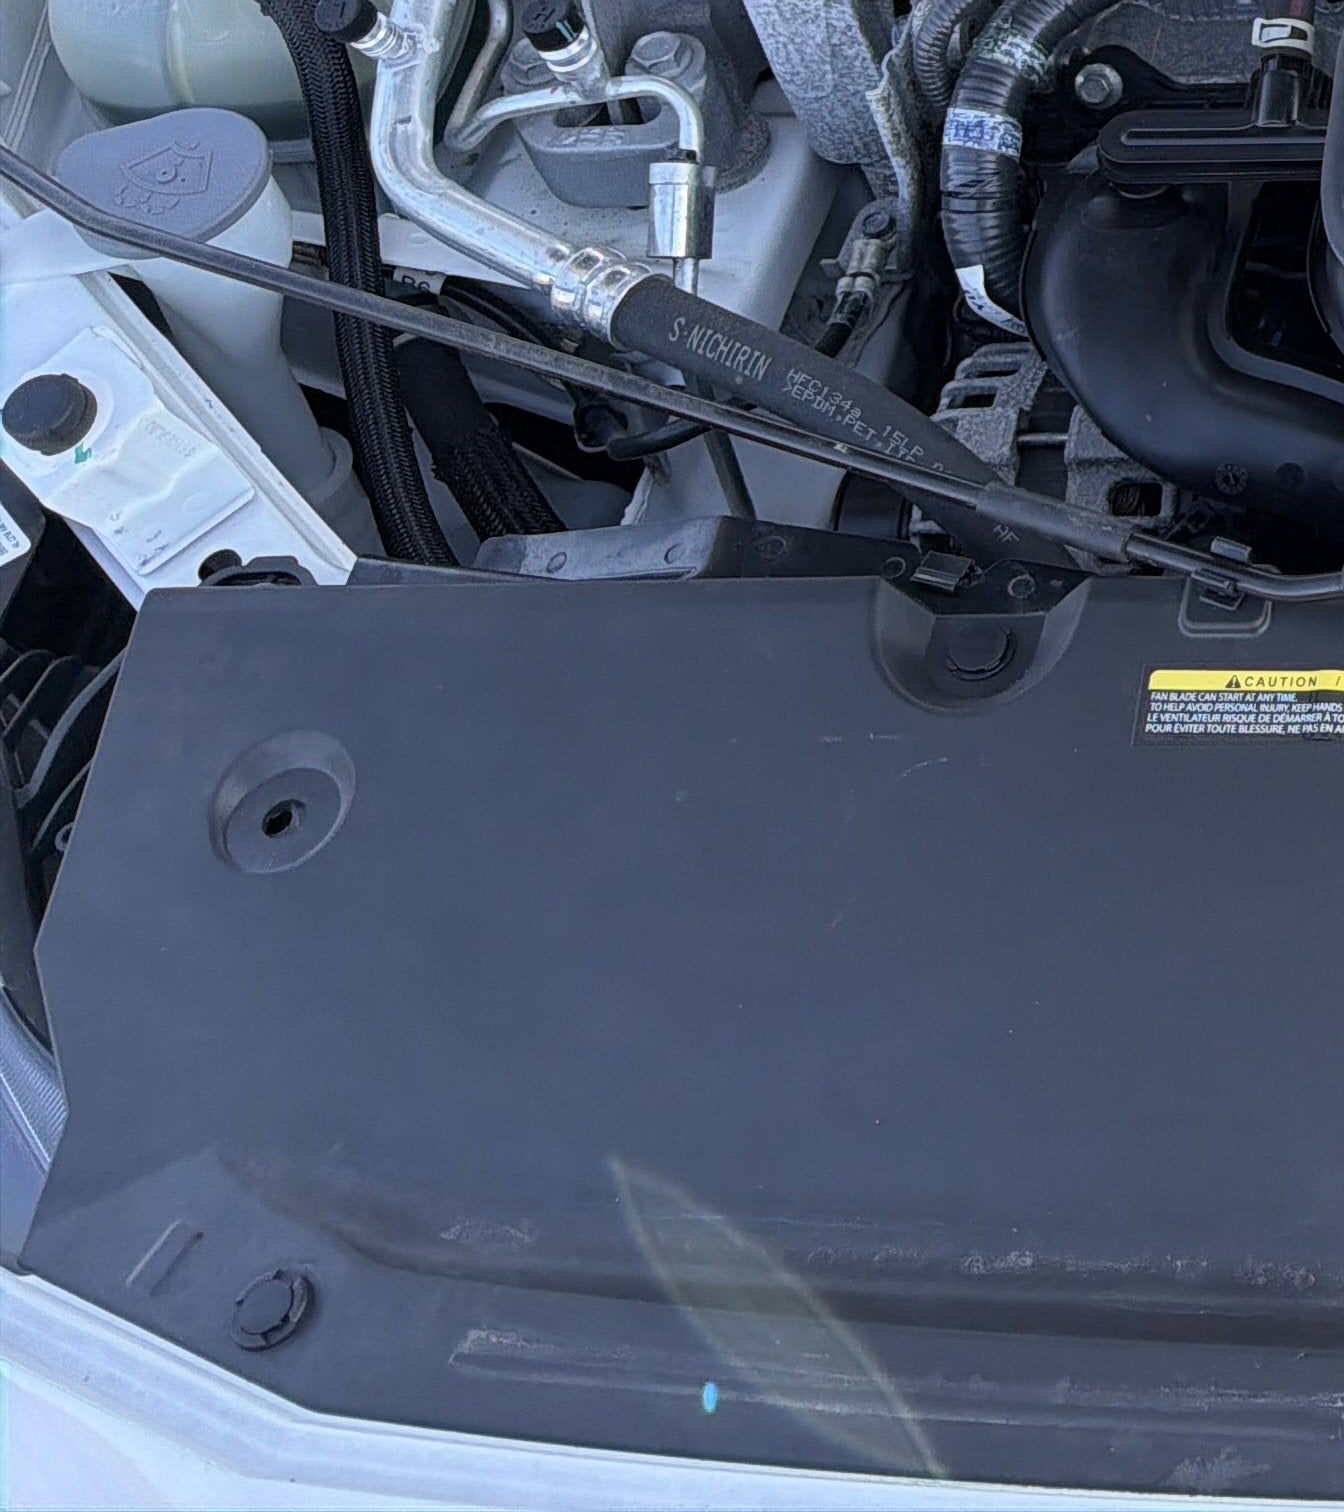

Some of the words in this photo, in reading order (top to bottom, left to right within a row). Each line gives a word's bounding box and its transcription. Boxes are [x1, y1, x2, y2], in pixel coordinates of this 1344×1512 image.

[788, 369, 862, 420] HFC134a
[882, 425, 924, 458] 15LP
[1244, 676, 1317, 687] CAUTION
[1151, 692, 1168, 702] FAN
[1169, 692, 1197, 702] BLADE
[1198, 692, 1217, 702] CAN
[1219, 692, 1243, 702] START
[1244, 692, 1256, 702] AT
[1256, 692, 1275, 702] ANY
[1276, 692, 1298, 702] TIME.
[1150, 702, 1163, 713] TO
[1163, 702, 1185, 713] HELP
[1186, 702, 1213, 713] AVOID
[1214, 702, 1258, 713] PERSONAL
[1291, 702, 1313, 713] KEEP
[1312, 702, 1342, 713] HANDS
[1147, 713, 1160, 723] LE
[1160, 713, 1220, 723] VENTILATEUR
[1222, 713, 1256, 723] RISQUE
[1258, 713, 1271, 723] DE
[1145, 723, 1173, 734] POUR
[1173, 723, 1205, 734] ÉVITER
[1206, 723, 1238, 734] TOUTE
[1287, 723, 1301, 734] NE
[1302, 723, 1319, 734] PAS
[1319, 723, 1334, 734] EN
